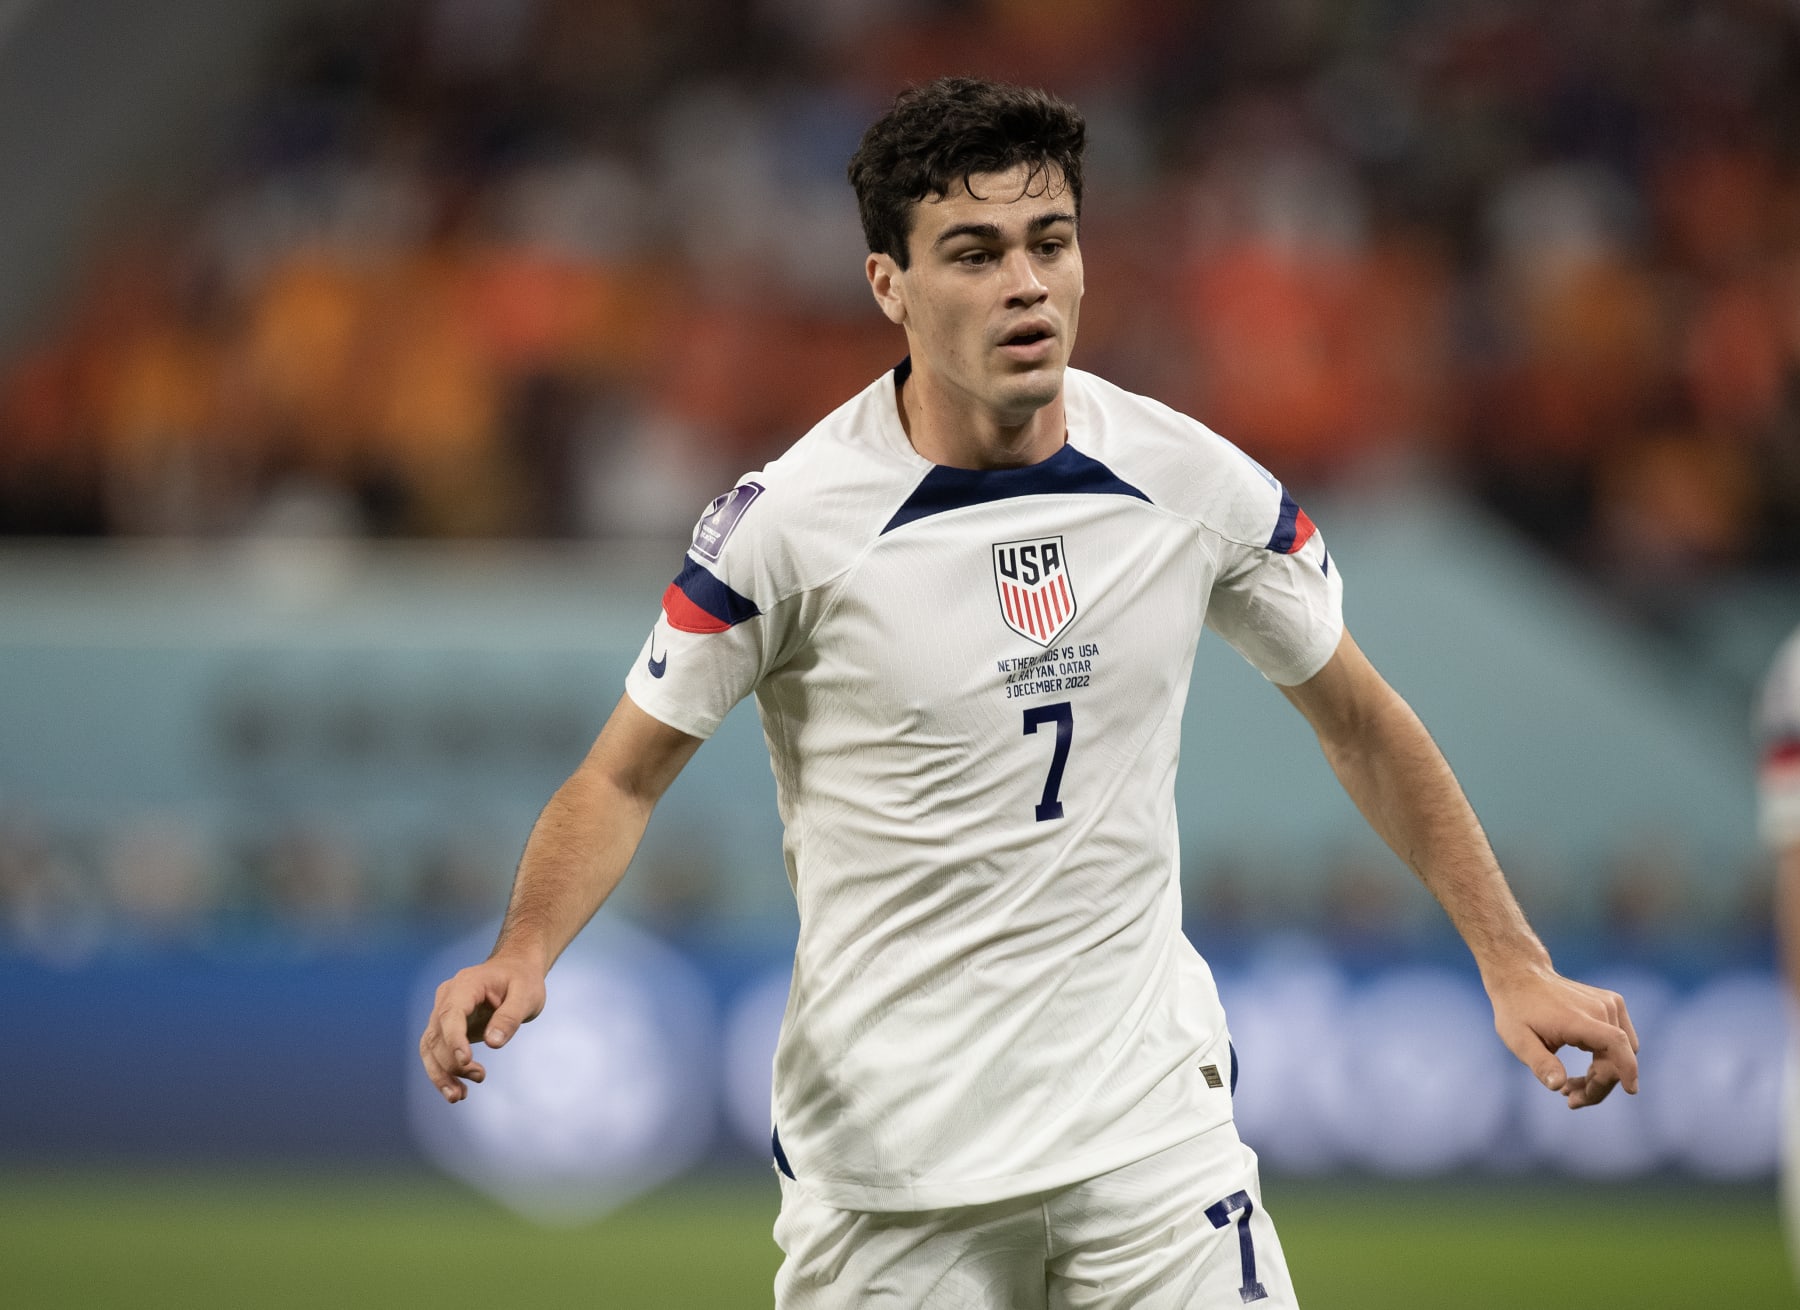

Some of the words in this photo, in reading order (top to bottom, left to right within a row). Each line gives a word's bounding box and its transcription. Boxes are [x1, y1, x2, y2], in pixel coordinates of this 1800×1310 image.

[998, 543, 1060, 586] USA
[1061, 646, 1074, 660] VS
[1078, 643, 1100, 658] USA
[1005, 674, 1016, 685] AL
[1059, 660, 1092, 676] QATAR
[1006, 686, 1012, 699] 3
[1013, 678, 1062, 698] DECEMBER
[1065, 675, 1090, 690] 2022
[1023, 701, 1074, 822] 7
[1203, 1189, 1269, 1304] 7
